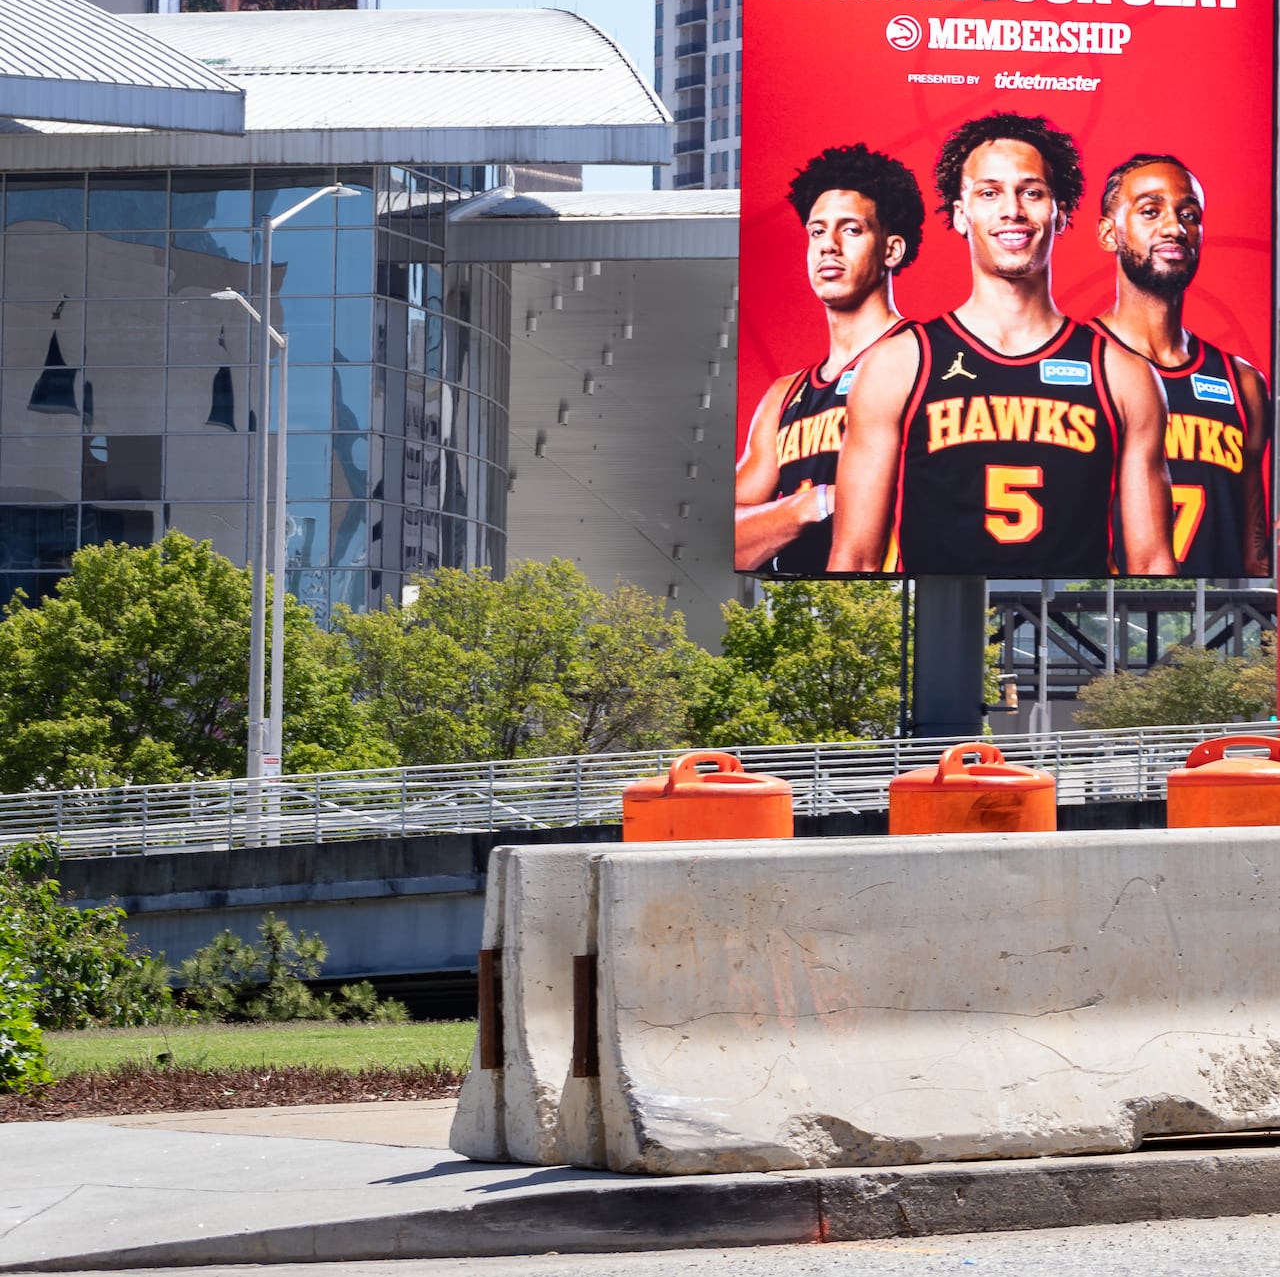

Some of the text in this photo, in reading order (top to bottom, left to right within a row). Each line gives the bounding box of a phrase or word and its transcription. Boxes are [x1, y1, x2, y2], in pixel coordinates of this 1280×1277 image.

[927, 17, 1132, 55] MEMBERSHIP
[907, 71, 1101, 92] PRESENTED BY ticketmaster
[1196, 379, 1229, 396] paze
[926, 395, 1097, 454] HAWKS
[1164, 413, 1244, 474] WKS
[984, 464, 1044, 545] 5
